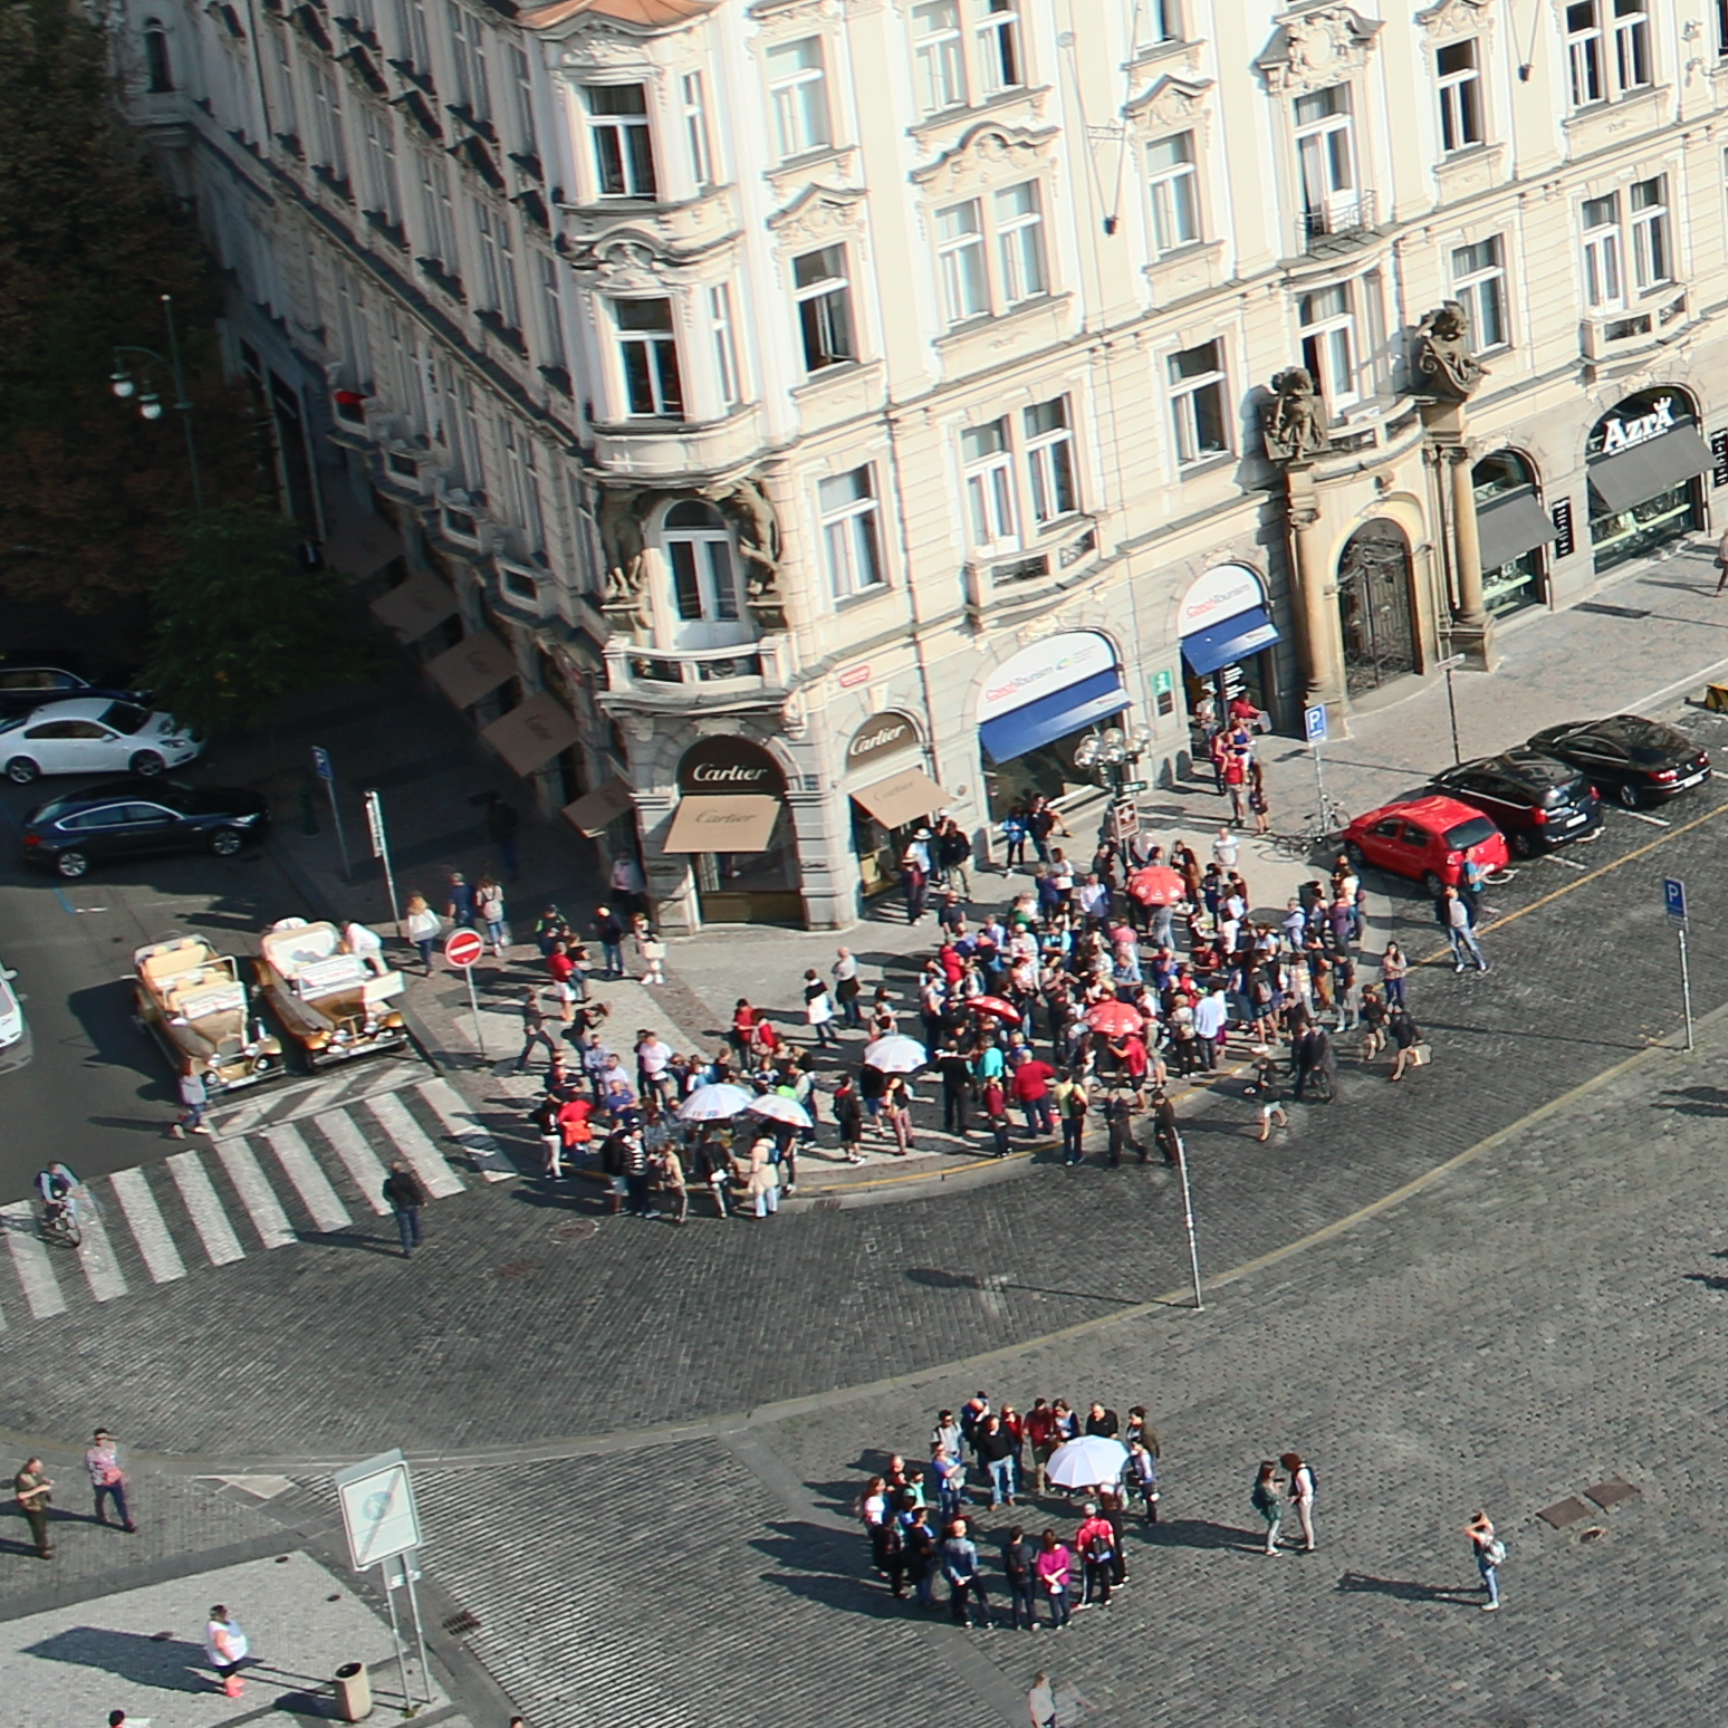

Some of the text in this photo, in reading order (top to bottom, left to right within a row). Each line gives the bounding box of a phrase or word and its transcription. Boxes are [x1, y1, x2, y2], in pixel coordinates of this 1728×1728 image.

[850, 723, 908, 756] Cartier
[692, 762, 768, 782] Cartier
[695, 809, 757, 824] Cartier
